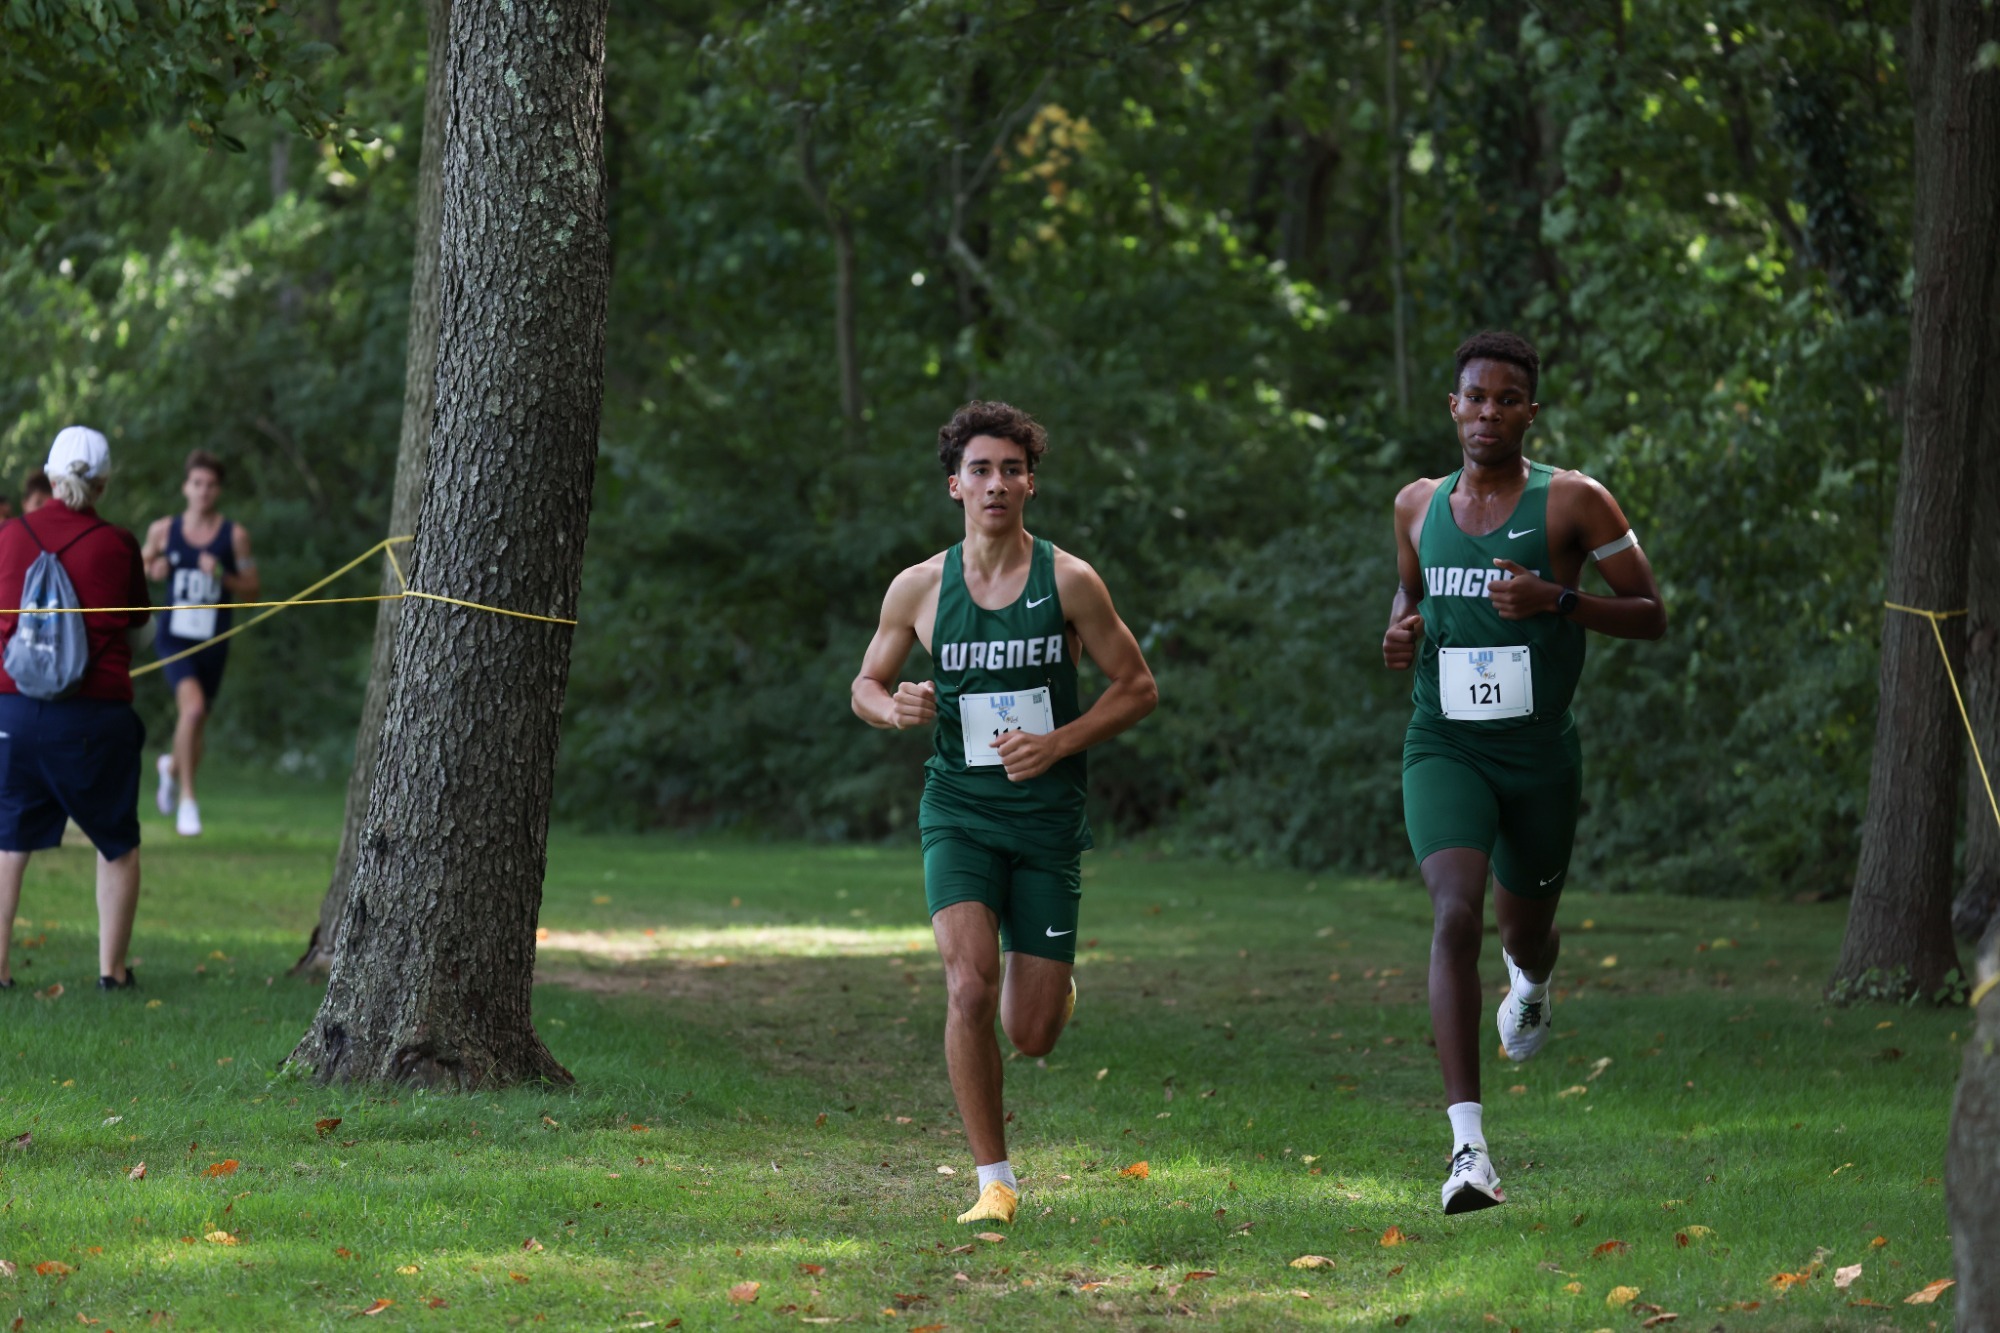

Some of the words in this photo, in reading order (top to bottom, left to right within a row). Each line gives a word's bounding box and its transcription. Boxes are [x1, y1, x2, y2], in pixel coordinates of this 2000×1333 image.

[1425, 567, 1540, 598] WAGN
[941, 635, 1062, 671] WAGNER
[1470, 683, 1501, 704] 121
